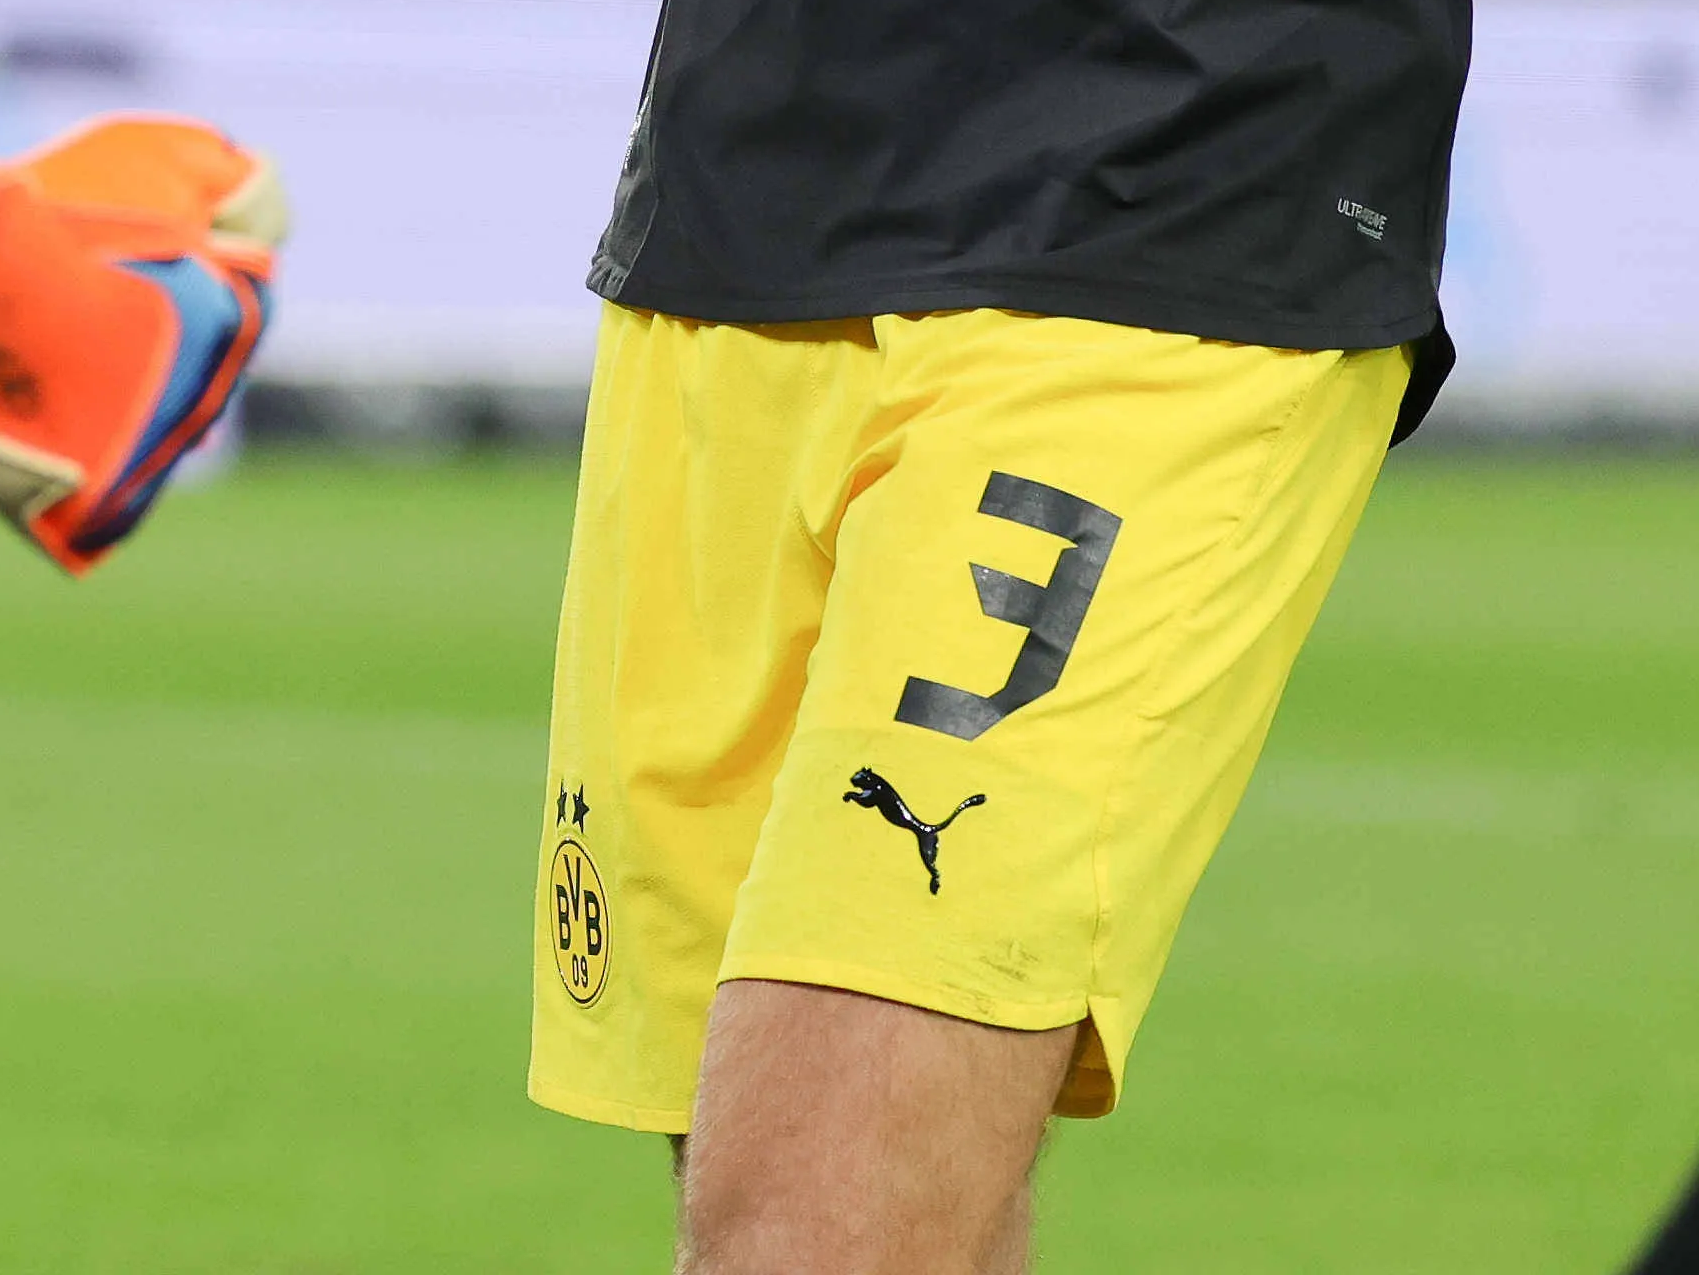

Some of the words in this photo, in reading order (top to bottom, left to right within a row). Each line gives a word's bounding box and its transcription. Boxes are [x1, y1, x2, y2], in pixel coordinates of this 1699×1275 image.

[894, 471, 1122, 740] 3
[556, 854, 602, 956] BVB
[571, 954, 589, 988] 09
